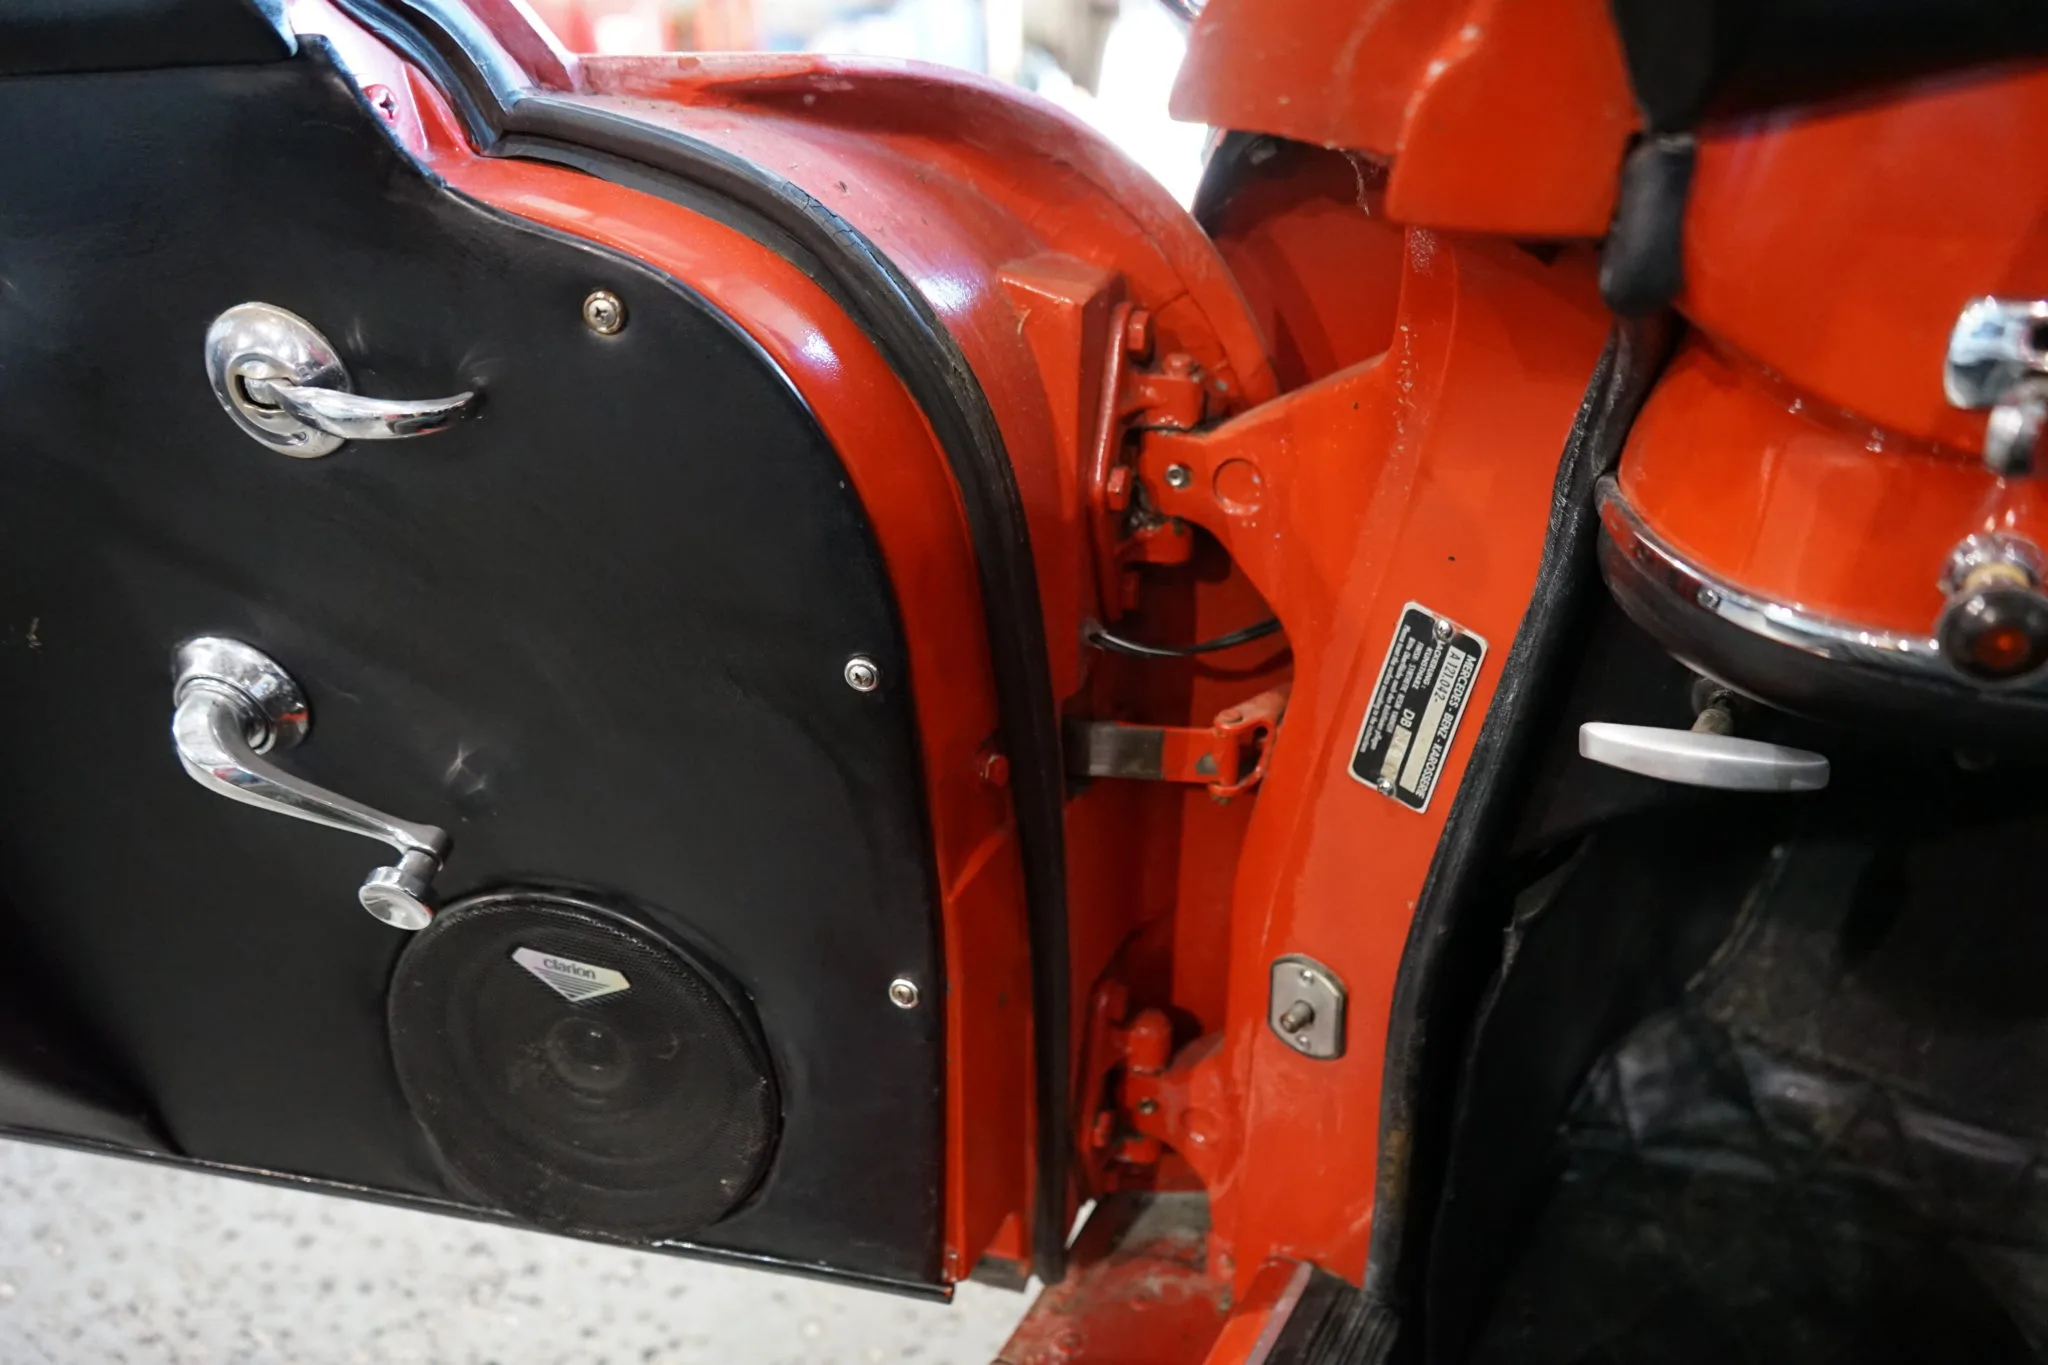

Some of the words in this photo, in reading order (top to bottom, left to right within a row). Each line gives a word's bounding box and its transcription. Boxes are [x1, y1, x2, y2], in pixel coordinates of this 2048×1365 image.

[1411, 645, 1433, 690] KUNSTHARZ
[1448, 651, 1461, 661] A
[1448, 653, 1476, 708] MERCEDES
[1399, 708, 1415, 728] DB
[1436, 712, 1453, 739] BENZ
[1415, 742, 1442, 799] KAROSSERIE
